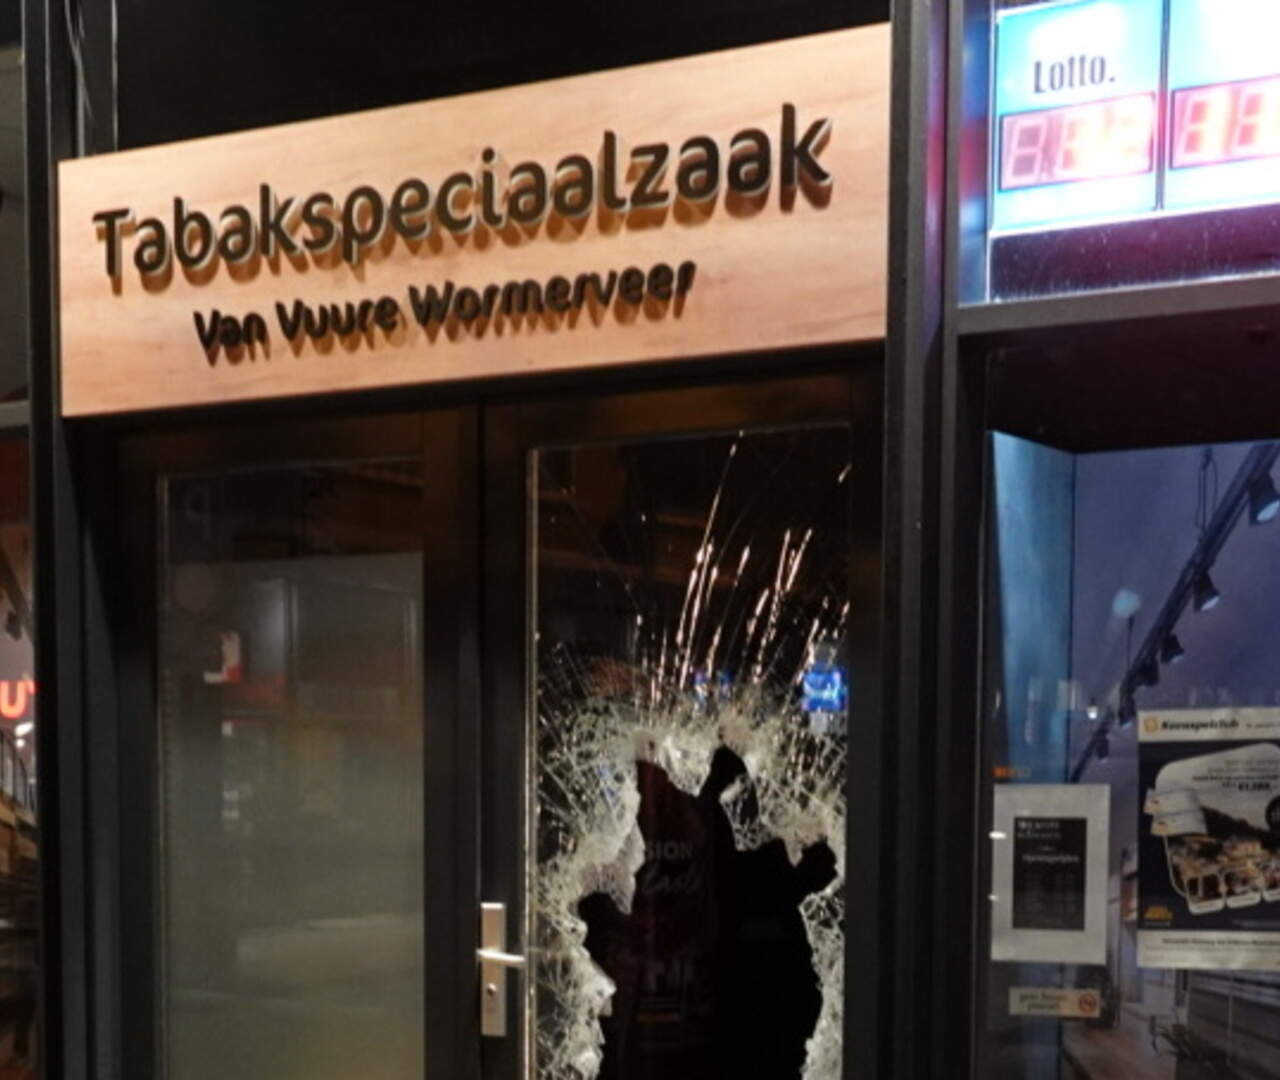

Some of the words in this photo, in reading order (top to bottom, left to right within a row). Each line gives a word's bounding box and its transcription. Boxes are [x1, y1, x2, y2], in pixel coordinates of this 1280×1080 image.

[1033, 54, 1115, 94] Lotto.
[92, 103, 833, 279] Tabakspeciaalzaak
[194, 308, 268, 351] Van
[275, 295, 399, 342] Vuure
[408, 260, 697, 327] Wormerveer
